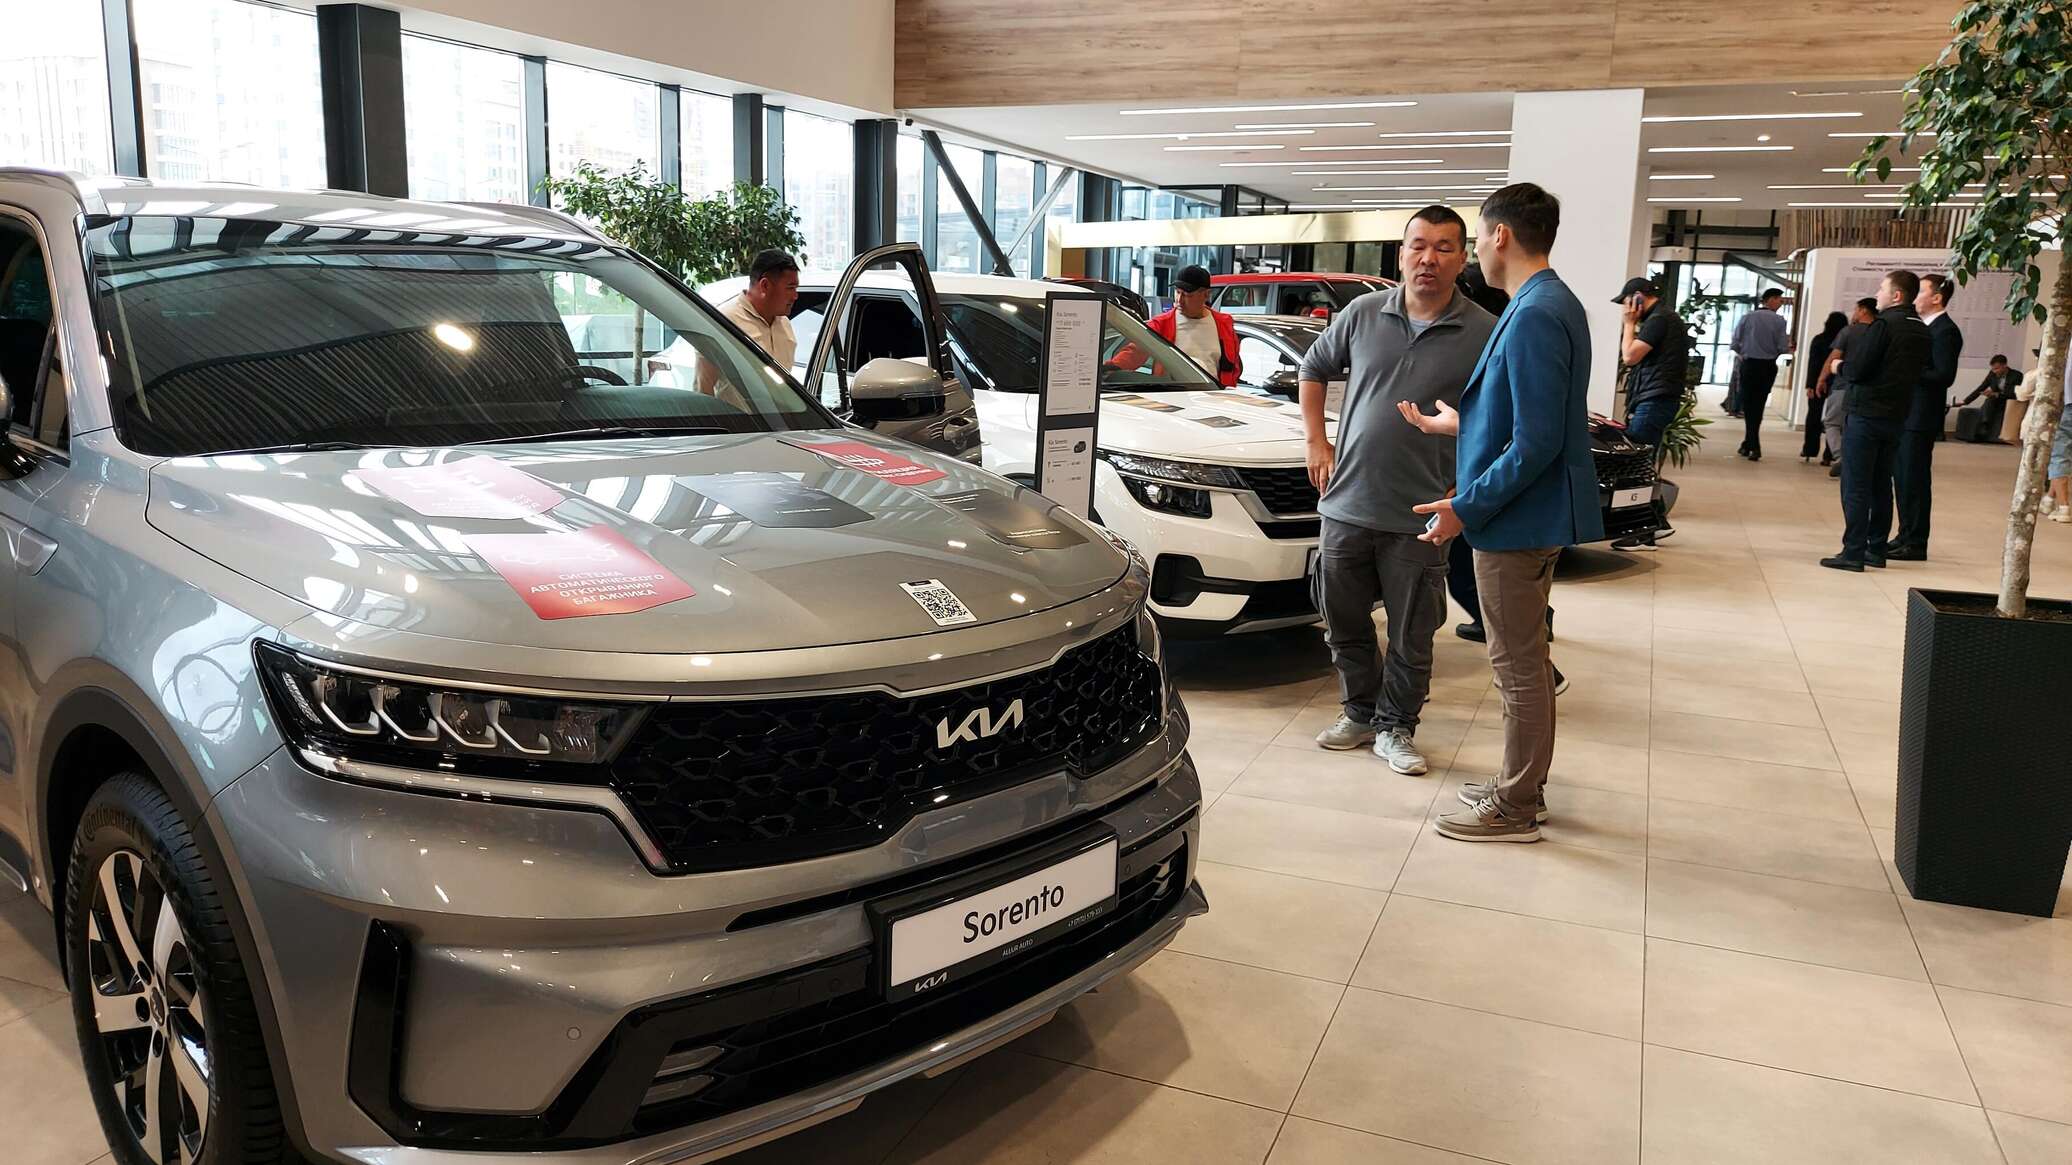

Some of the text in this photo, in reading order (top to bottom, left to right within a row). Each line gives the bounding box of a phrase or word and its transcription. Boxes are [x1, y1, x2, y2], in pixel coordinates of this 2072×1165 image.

[530, 573, 665, 594] АВТОМАТИЧЕСКОГО
[559, 570, 625, 581] СИСТЕМА
[559, 582, 654, 598] ОТКРЫВАНИЯ
[574, 589, 657, 605] БАГАЖНИКА
[937, 698, 1024, 749] KIA
[963, 883, 1064, 944] Sorento
[915, 972, 949, 993] KIA
